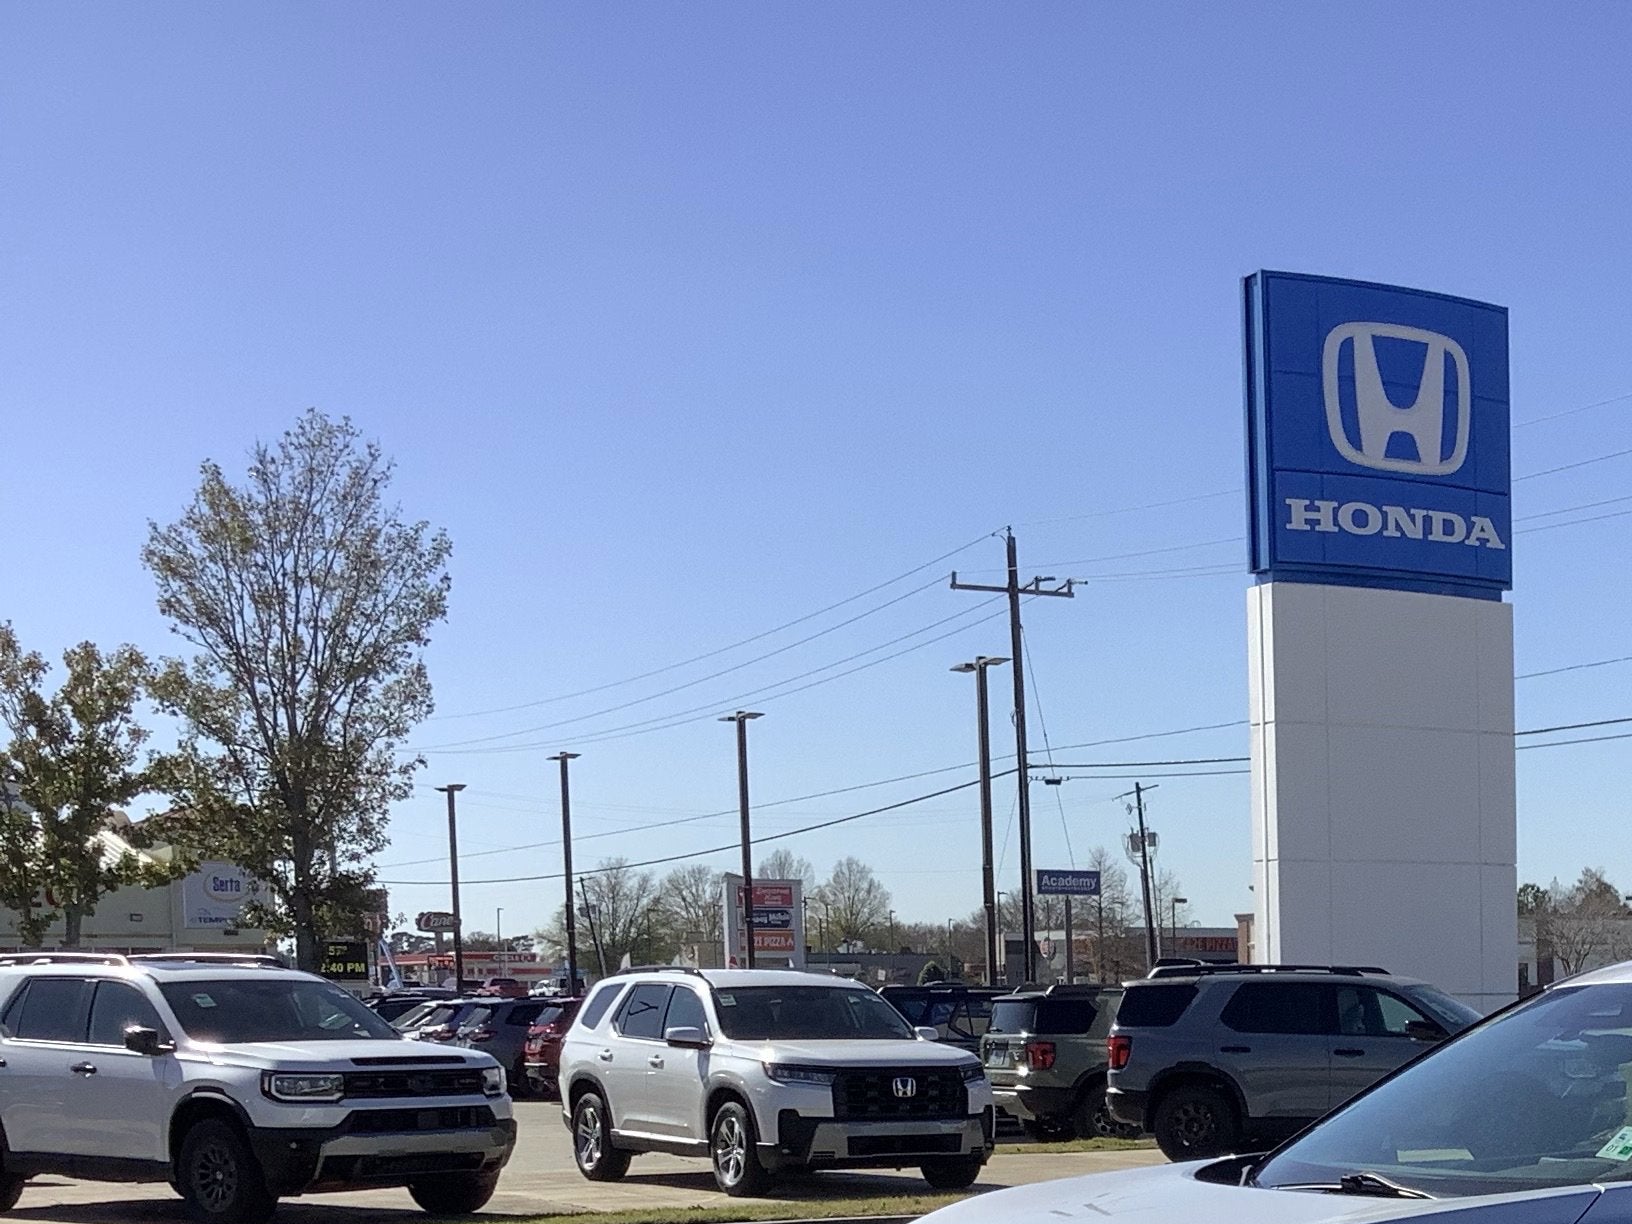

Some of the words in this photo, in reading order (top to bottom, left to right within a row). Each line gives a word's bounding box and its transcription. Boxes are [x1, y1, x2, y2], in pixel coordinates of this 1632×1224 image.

[1285, 498, 1506, 550] HONDA
[212, 876, 241, 892] Serta
[1041, 874, 1097, 890] Academy
[763, 936, 785, 948] PIZZA
[346, 962, 366, 973] PM
